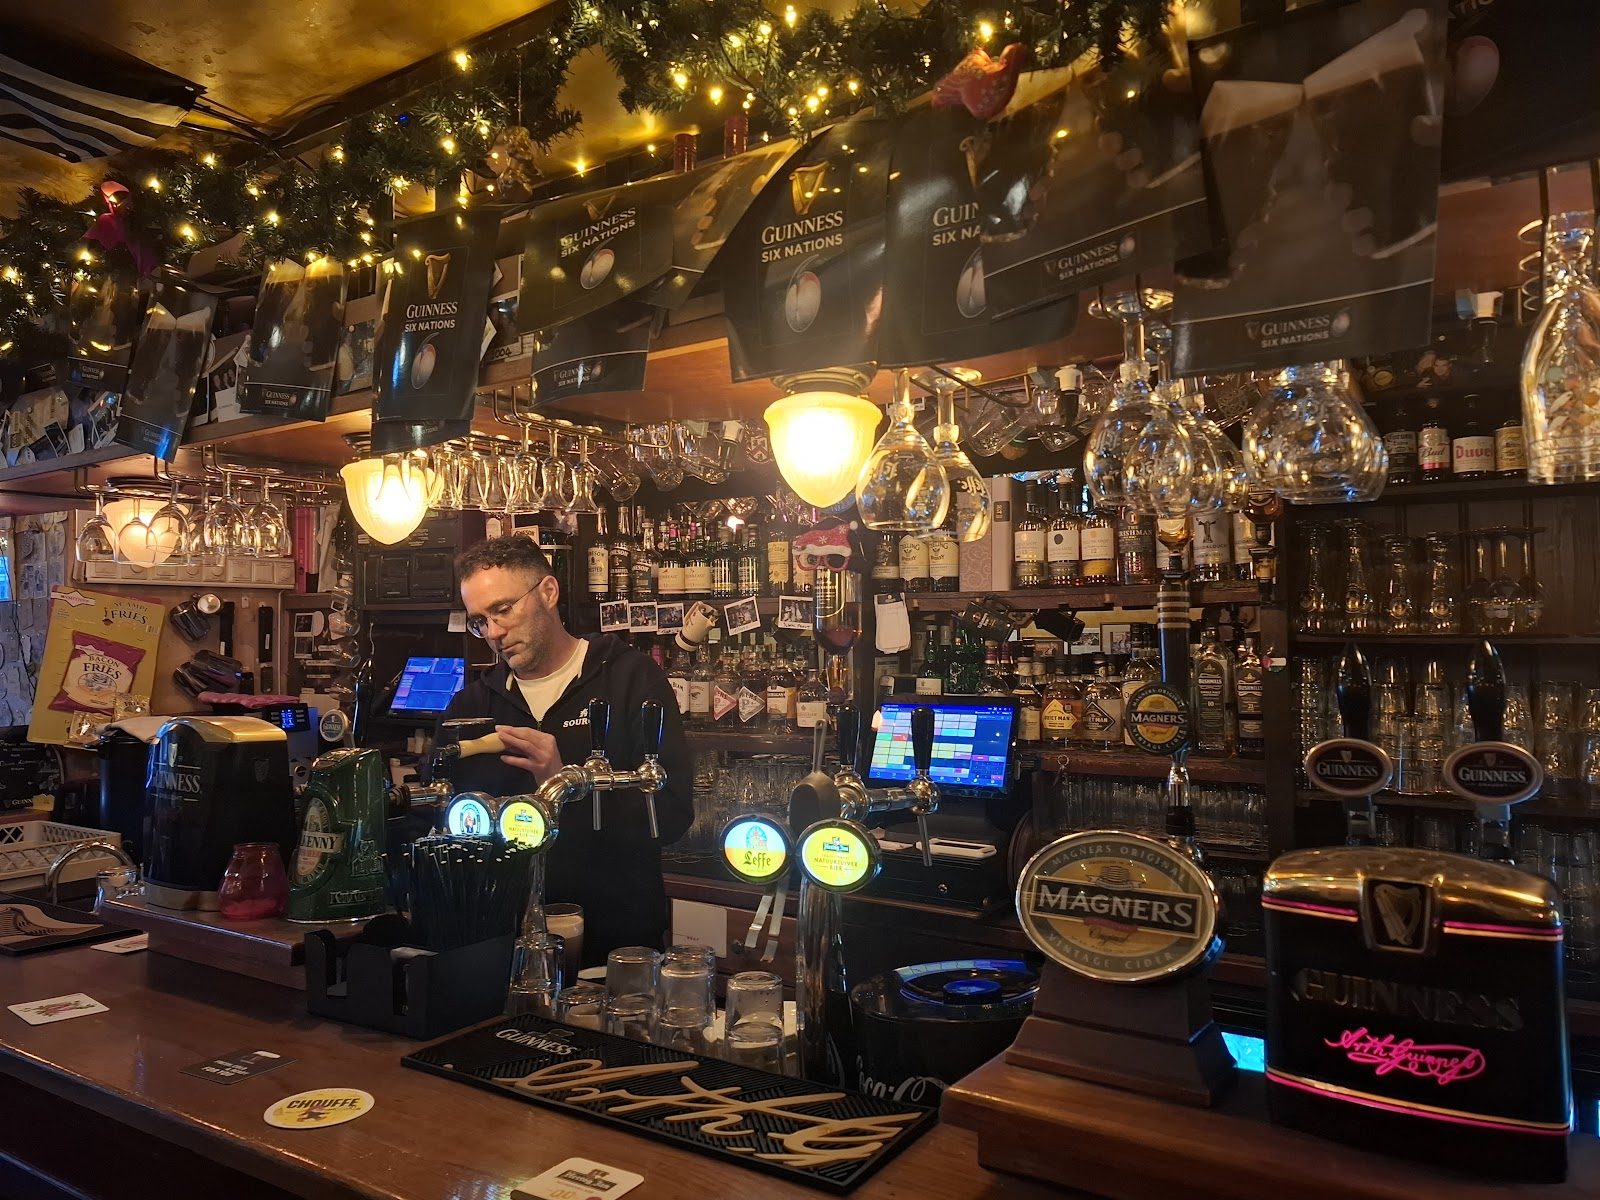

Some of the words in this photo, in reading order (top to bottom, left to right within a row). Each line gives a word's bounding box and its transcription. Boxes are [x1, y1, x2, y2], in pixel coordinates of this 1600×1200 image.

[560, 207, 636, 247] GUINNESS
[761, 210, 844, 245] GUINNESS
[561, 244, 579, 258] SIX
[582, 219, 636, 248] NATIONS
[932, 230, 957, 246] SIX
[761, 248, 781, 263] SIX
[784, 233, 843, 258] NATIONS
[1058, 242, 1118, 270] GUINNESS
[1059, 269, 1074, 280] SIX
[1076, 254, 1119, 274] NATIONS
[406, 301, 458, 319] GUINNESS
[404, 323, 417, 333] SIX
[418, 319, 456, 331] NATIONS
[1261, 314, 1330, 336] GUINNESS
[1261, 339, 1279, 348] SIX
[1280, 330, 1329, 346] NATIONS
[559, 367, 591, 379] GUINSS
[1421, 447, 1446, 457] Bud
[111, 609, 148, 625] FRIES
[89, 655, 120, 668] BACON
[83, 662, 122, 680] FRIES
[562, 717, 590, 728] SOUR
[1130, 712, 1185, 724] MAGNERS
[1316, 761, 1379, 778] GUINNESS
[1458, 766, 1528, 784] GUINNESS
[743, 850, 771, 869] Leffe
[1052, 844, 1112, 865] MAGNERS
[1119, 846, 1187, 882] ORIGINAL
[1037, 884, 1193, 928] MAGNERS
[1048, 932, 1111, 968] VINTAGE
[1124, 951, 1175, 970] CIDER
[1291, 967, 1524, 1032] GUINNESS
[495, 1028, 577, 1055] GUINNESS
[286, 1097, 360, 1109] CHOUFFE
